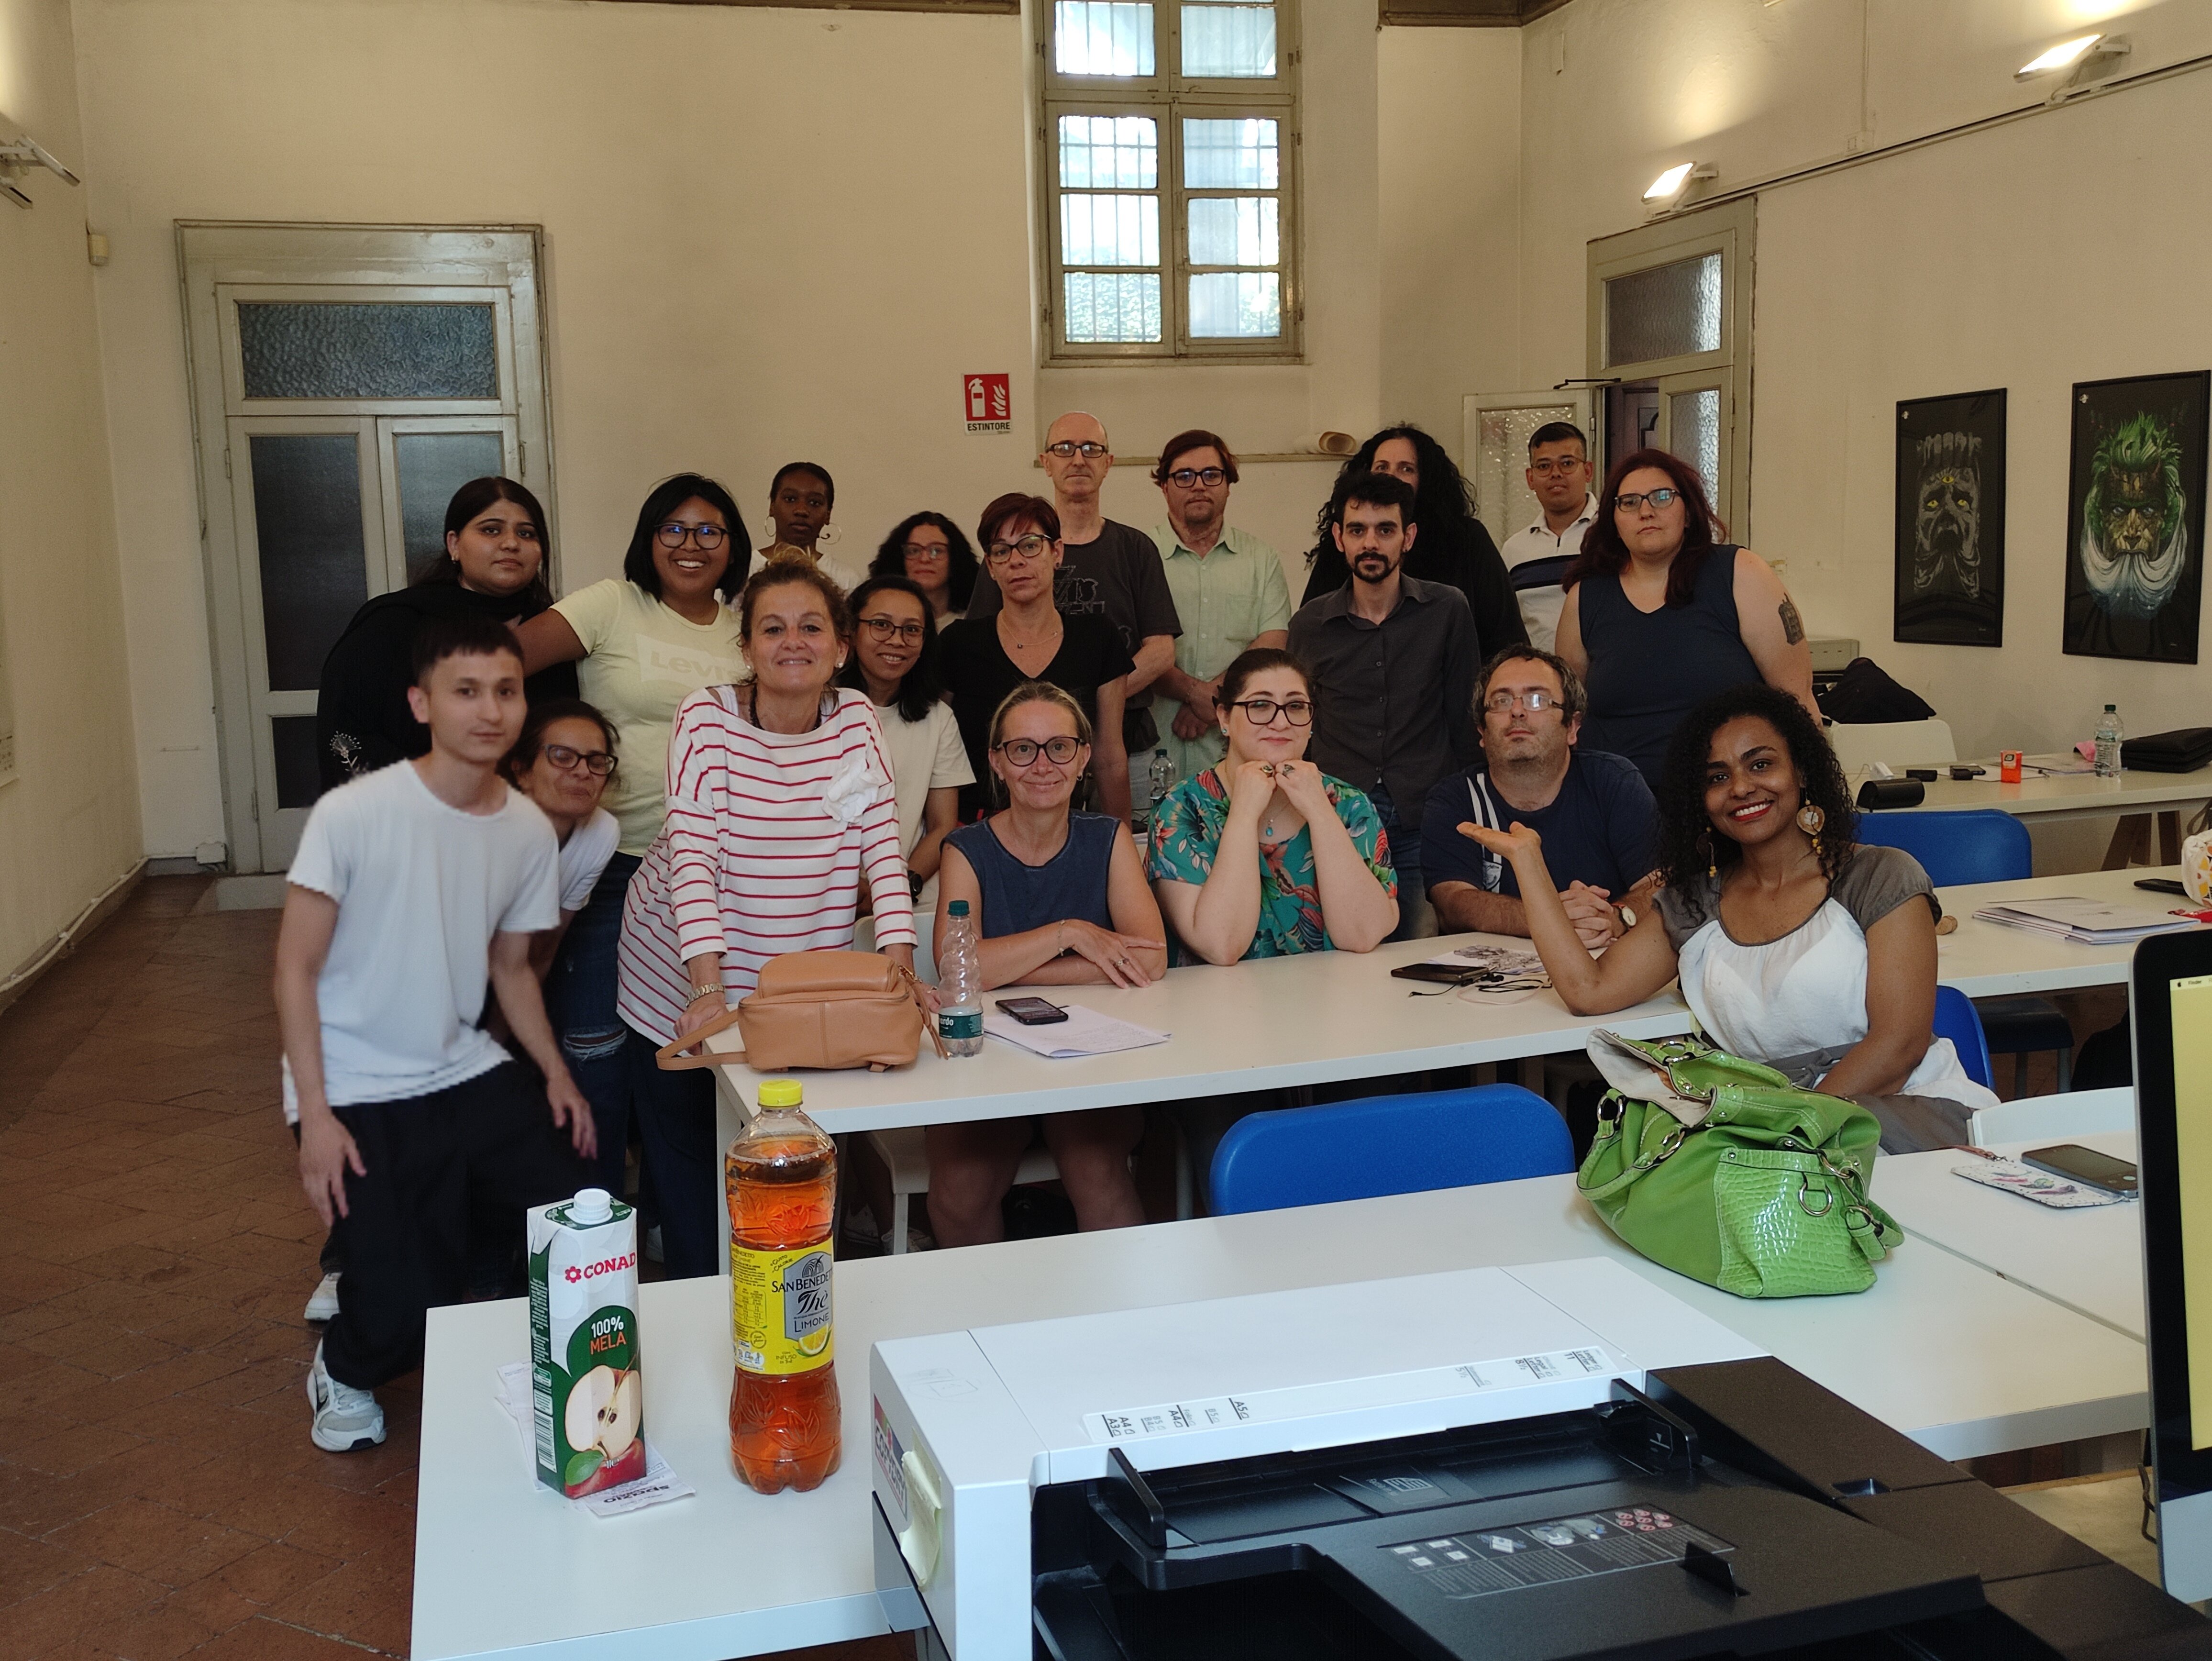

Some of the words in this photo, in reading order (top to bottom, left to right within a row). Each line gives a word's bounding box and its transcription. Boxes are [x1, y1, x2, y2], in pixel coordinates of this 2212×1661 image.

[967, 422, 1010, 431] ESTINTORE
[584, 1252, 636, 1279] CONAD
[591, 1316, 624, 1338] 100%
[794, 1312, 830, 1333] LIMONE
[590, 1331, 627, 1355] MELA
[1234, 1401, 1248, 1412] A5
[1169, 1410, 1181, 1421] A4
[1208, 1408, 1218, 1417] B5
[1107, 1418, 1120, 1429] A3
[1118, 1417, 1131, 1428] A4
[1144, 1417, 1154, 1426] B4
[1153, 1416, 1163, 1424] B5
[604, 1485, 669, 1503] spazio
